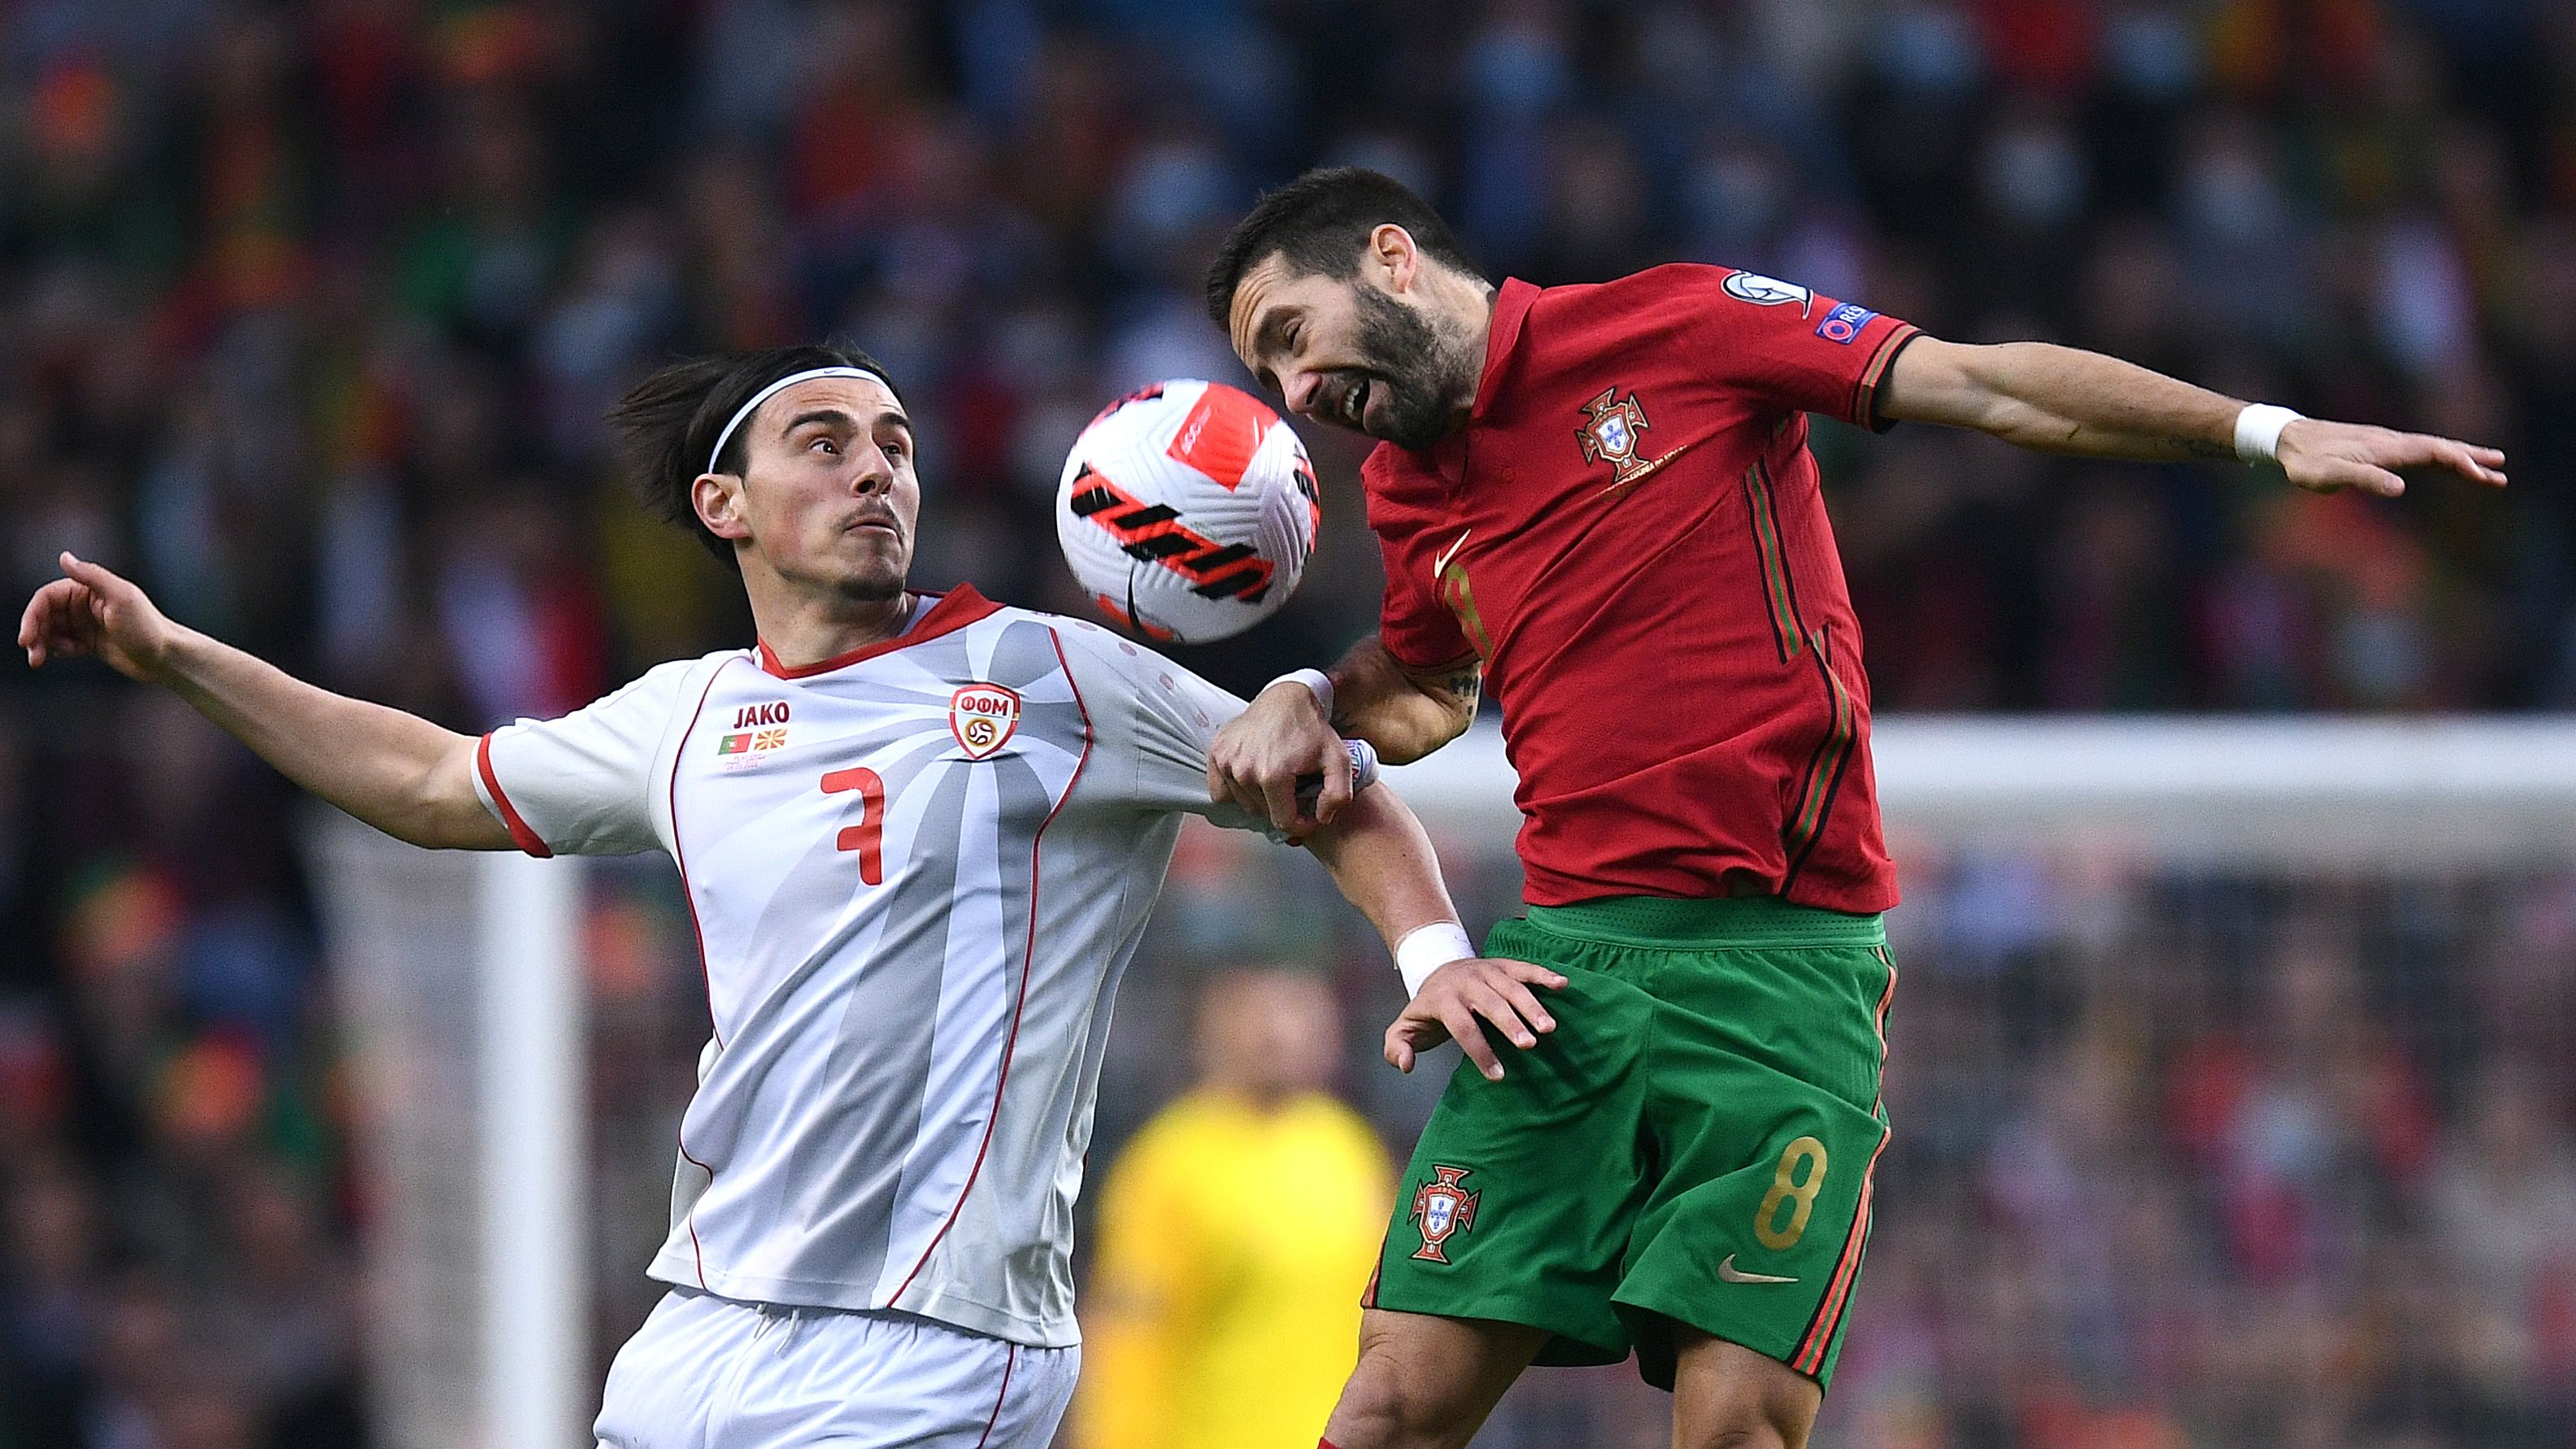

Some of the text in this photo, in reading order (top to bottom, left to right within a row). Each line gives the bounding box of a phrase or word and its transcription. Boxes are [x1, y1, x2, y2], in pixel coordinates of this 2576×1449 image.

[733, 702, 790, 729] JAKO
[960, 695, 1009, 716] ФФМ
[820, 767, 885, 886] 7
[1754, 1136, 1828, 1251] 8
